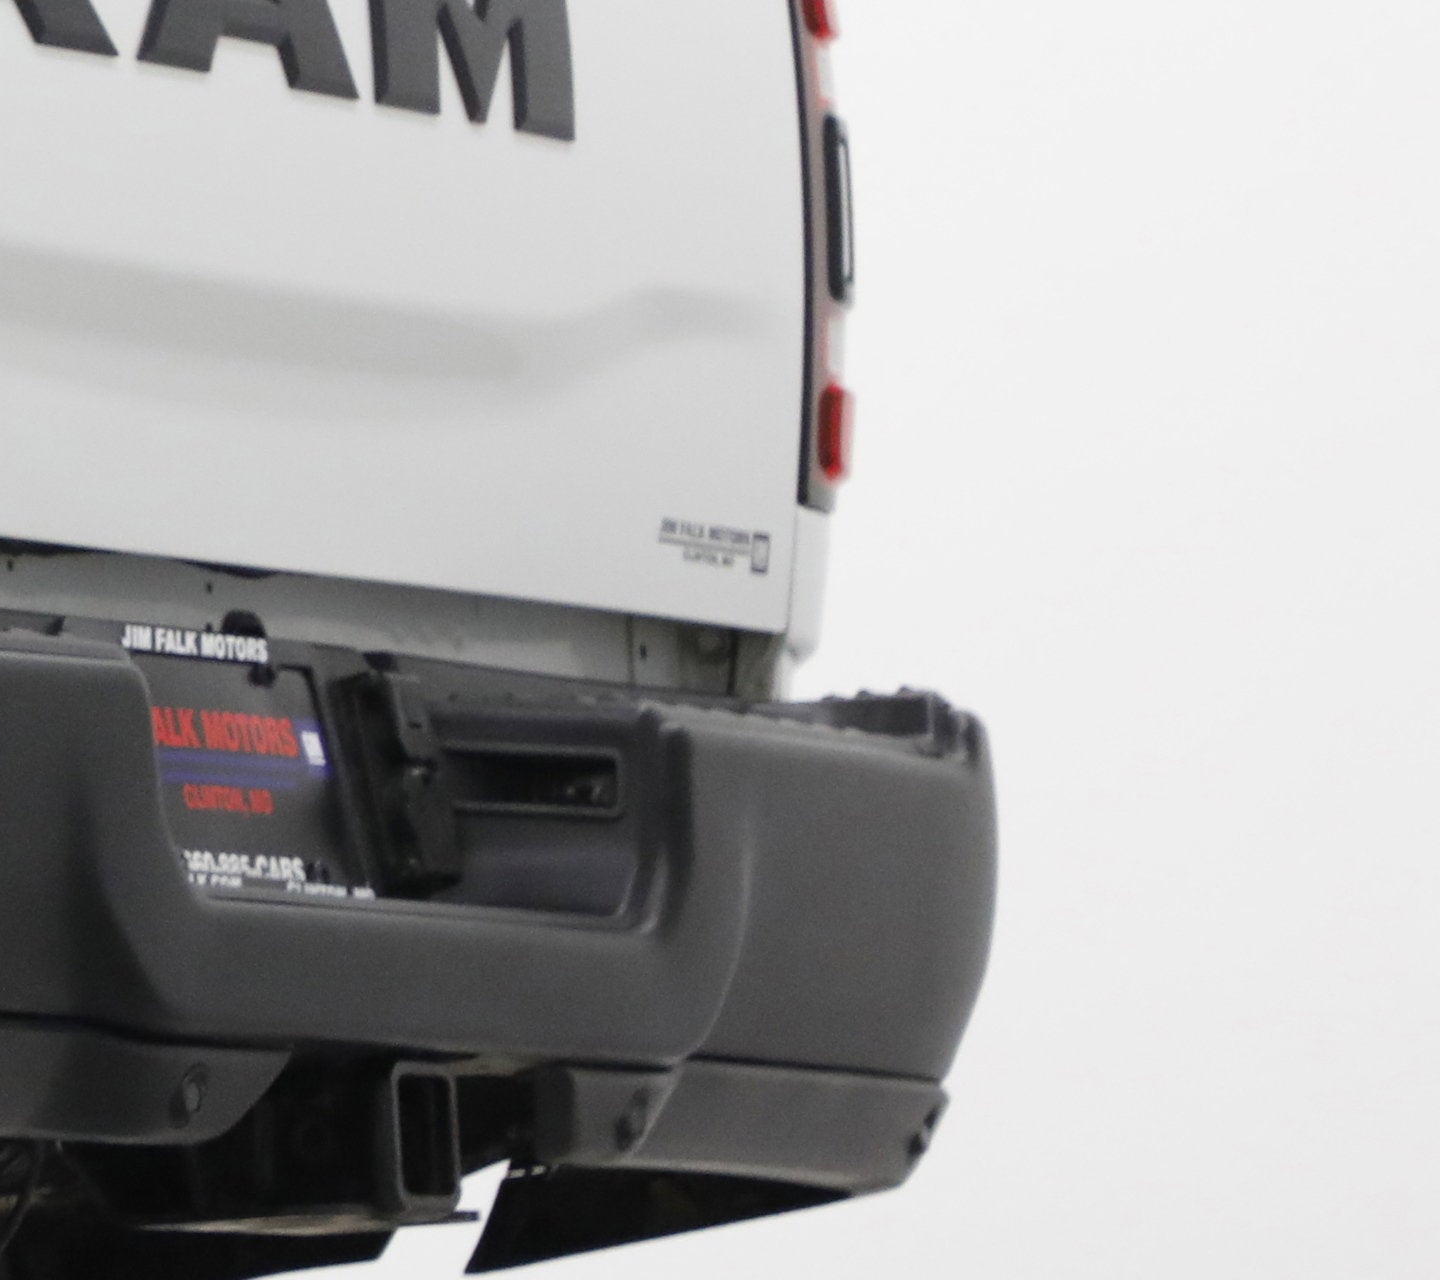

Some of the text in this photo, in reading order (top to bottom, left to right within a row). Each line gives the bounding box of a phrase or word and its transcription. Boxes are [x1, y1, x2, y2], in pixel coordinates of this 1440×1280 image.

[121, 624, 268, 663] JIM FALK MOTORS
[152, 706, 298, 758] ALK MOTORS
